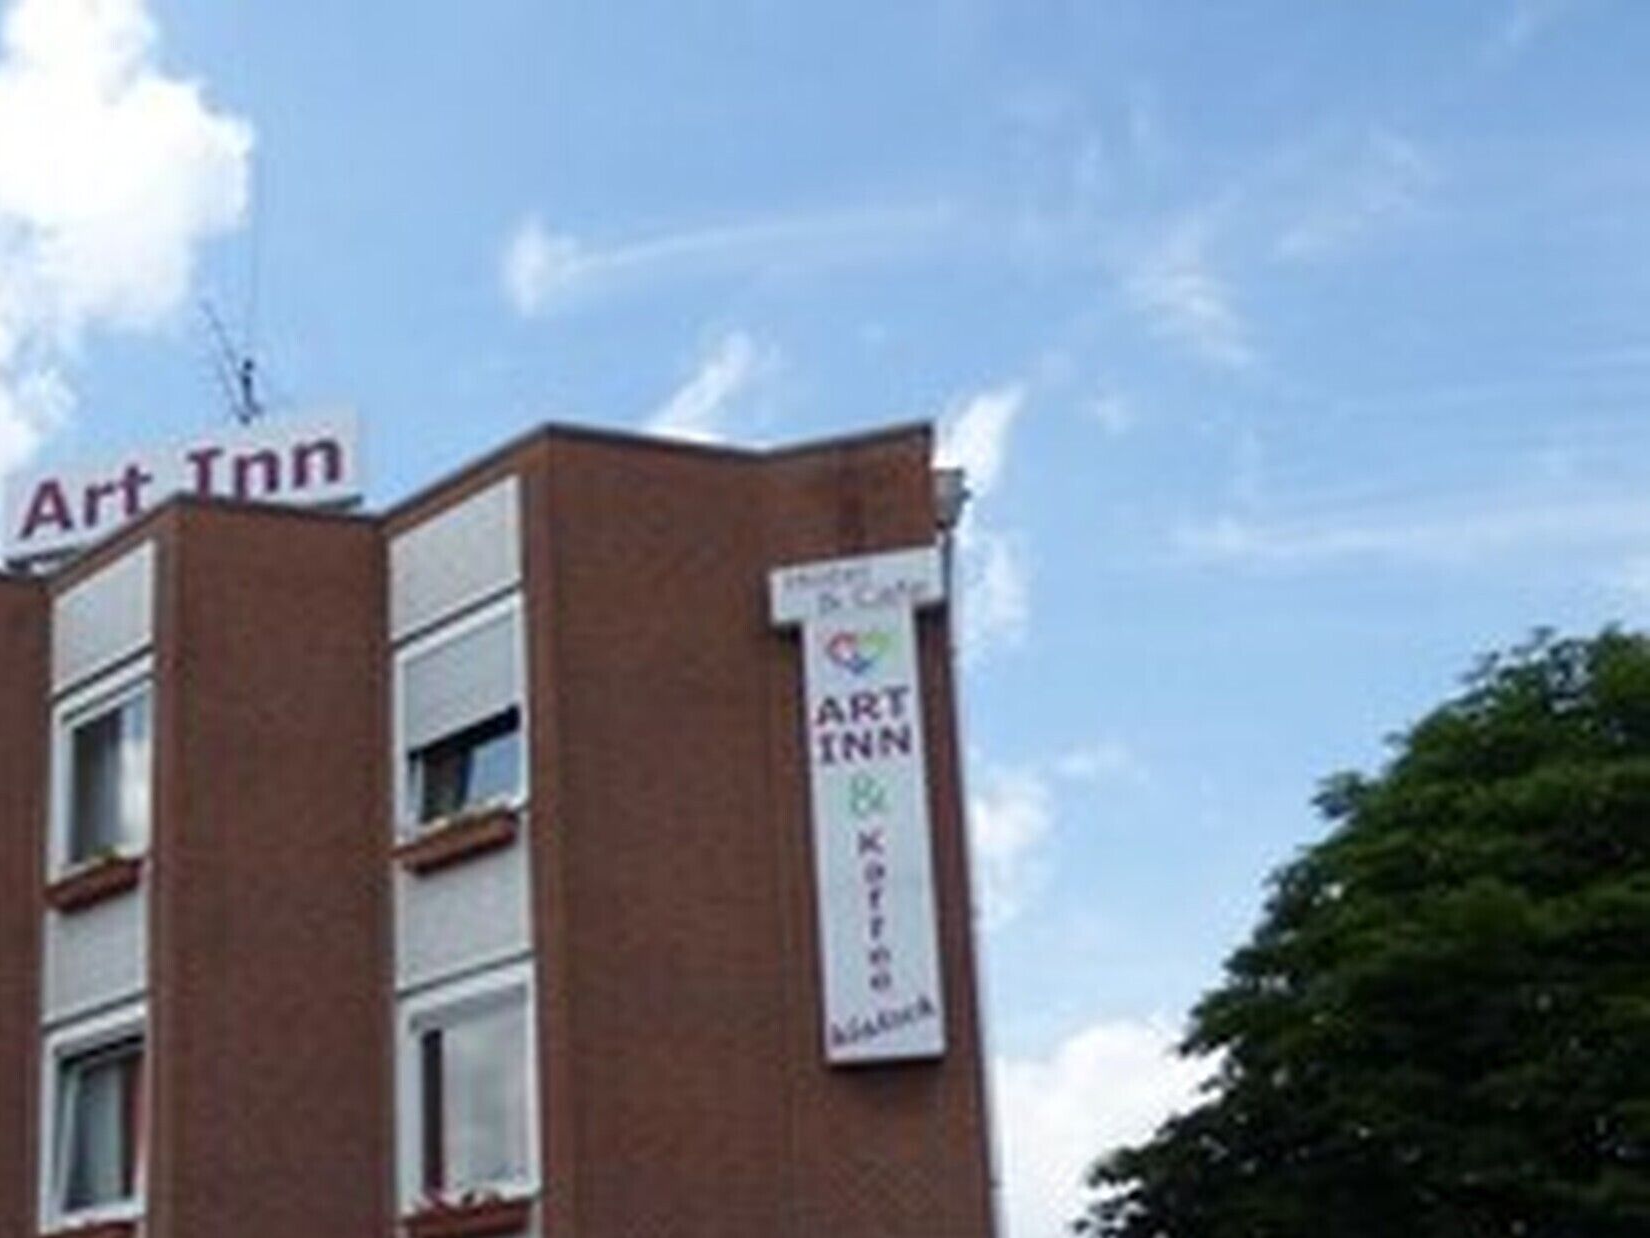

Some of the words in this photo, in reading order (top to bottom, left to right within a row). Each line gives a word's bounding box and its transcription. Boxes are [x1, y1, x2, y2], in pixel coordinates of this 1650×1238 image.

[19, 461, 154, 541] Art
[187, 436, 343, 499] Inn
[815, 684, 910, 726] ART
[818, 723, 912, 766] INN
